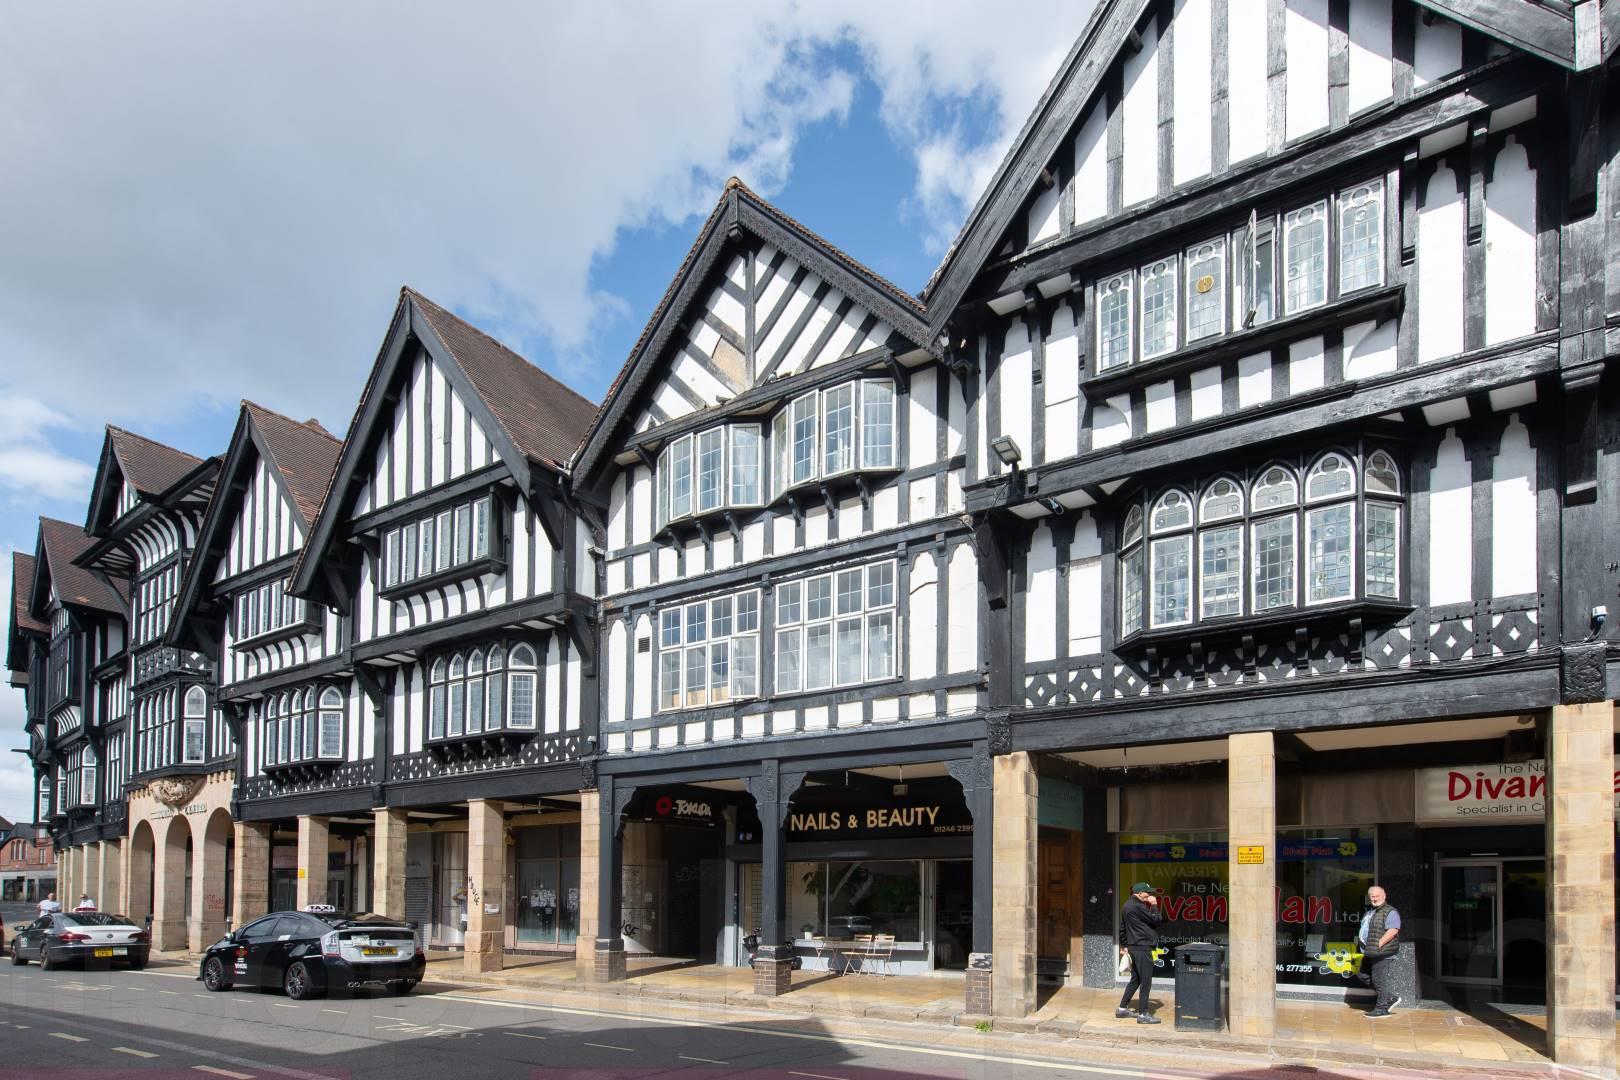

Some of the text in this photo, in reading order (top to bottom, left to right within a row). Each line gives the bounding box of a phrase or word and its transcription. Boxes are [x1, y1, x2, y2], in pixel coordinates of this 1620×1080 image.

[1528, 761, 1550, 772] Ne
[1448, 772, 1546, 801] Divan
[1456, 805, 1512, 815] Specialist
[1516, 803, 1526, 812] in
[790, 806, 940, 831] NAILS & BEAUTY
[1182, 882, 1230, 893] The Ne
[1130, 886, 1360, 924] ivan lan Ltd
